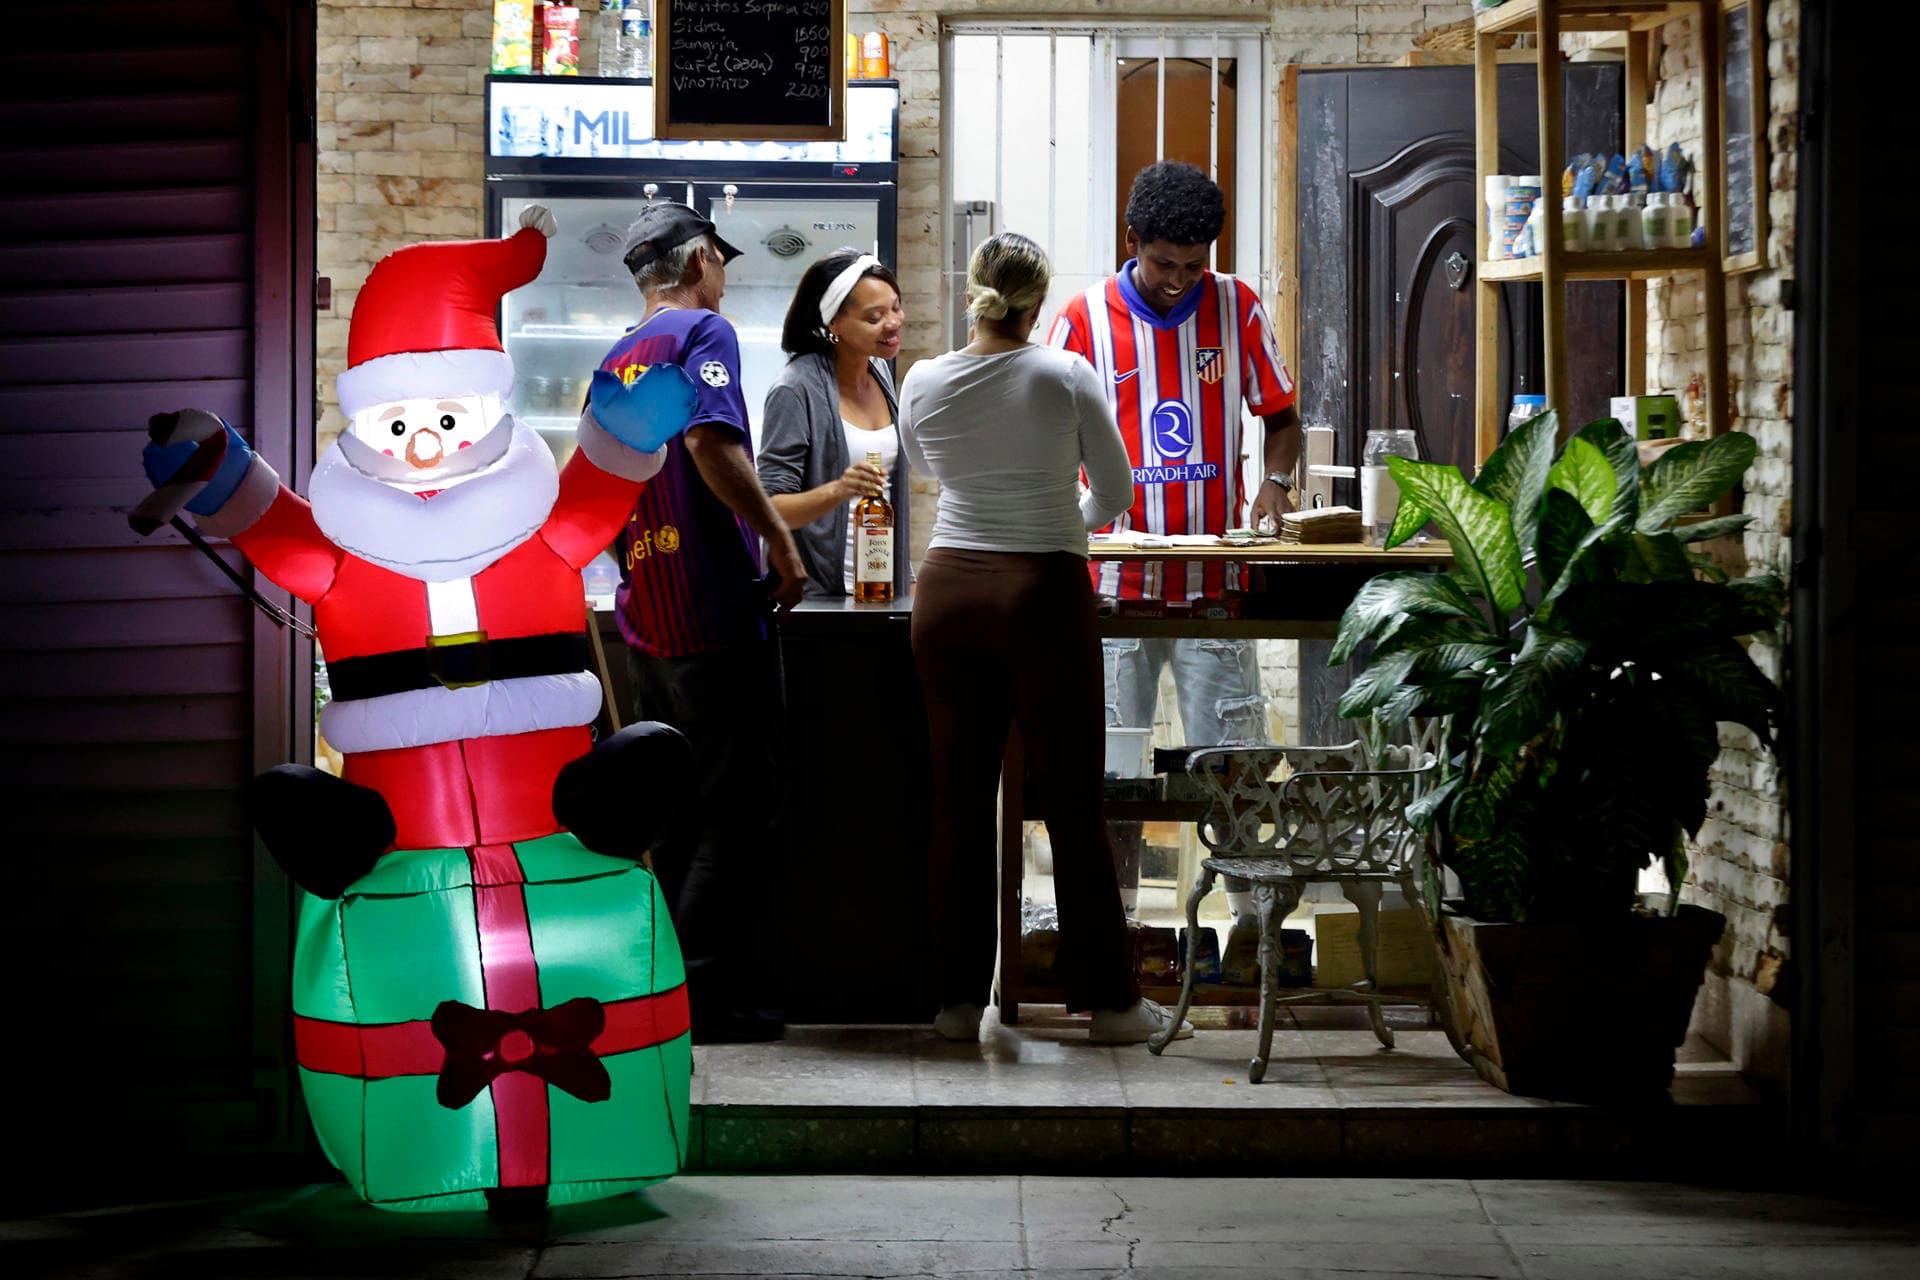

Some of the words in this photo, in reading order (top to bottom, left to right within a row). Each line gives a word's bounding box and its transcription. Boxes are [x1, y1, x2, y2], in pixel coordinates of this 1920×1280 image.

[802, 1, 829, 16] 240
[795, 25, 830, 42] 1550
[799, 46, 829, 63] 900
[785, 82, 827, 98] 2200
[1131, 466, 1189, 483] RIYADH
[1192, 463, 1218, 480] AIR
